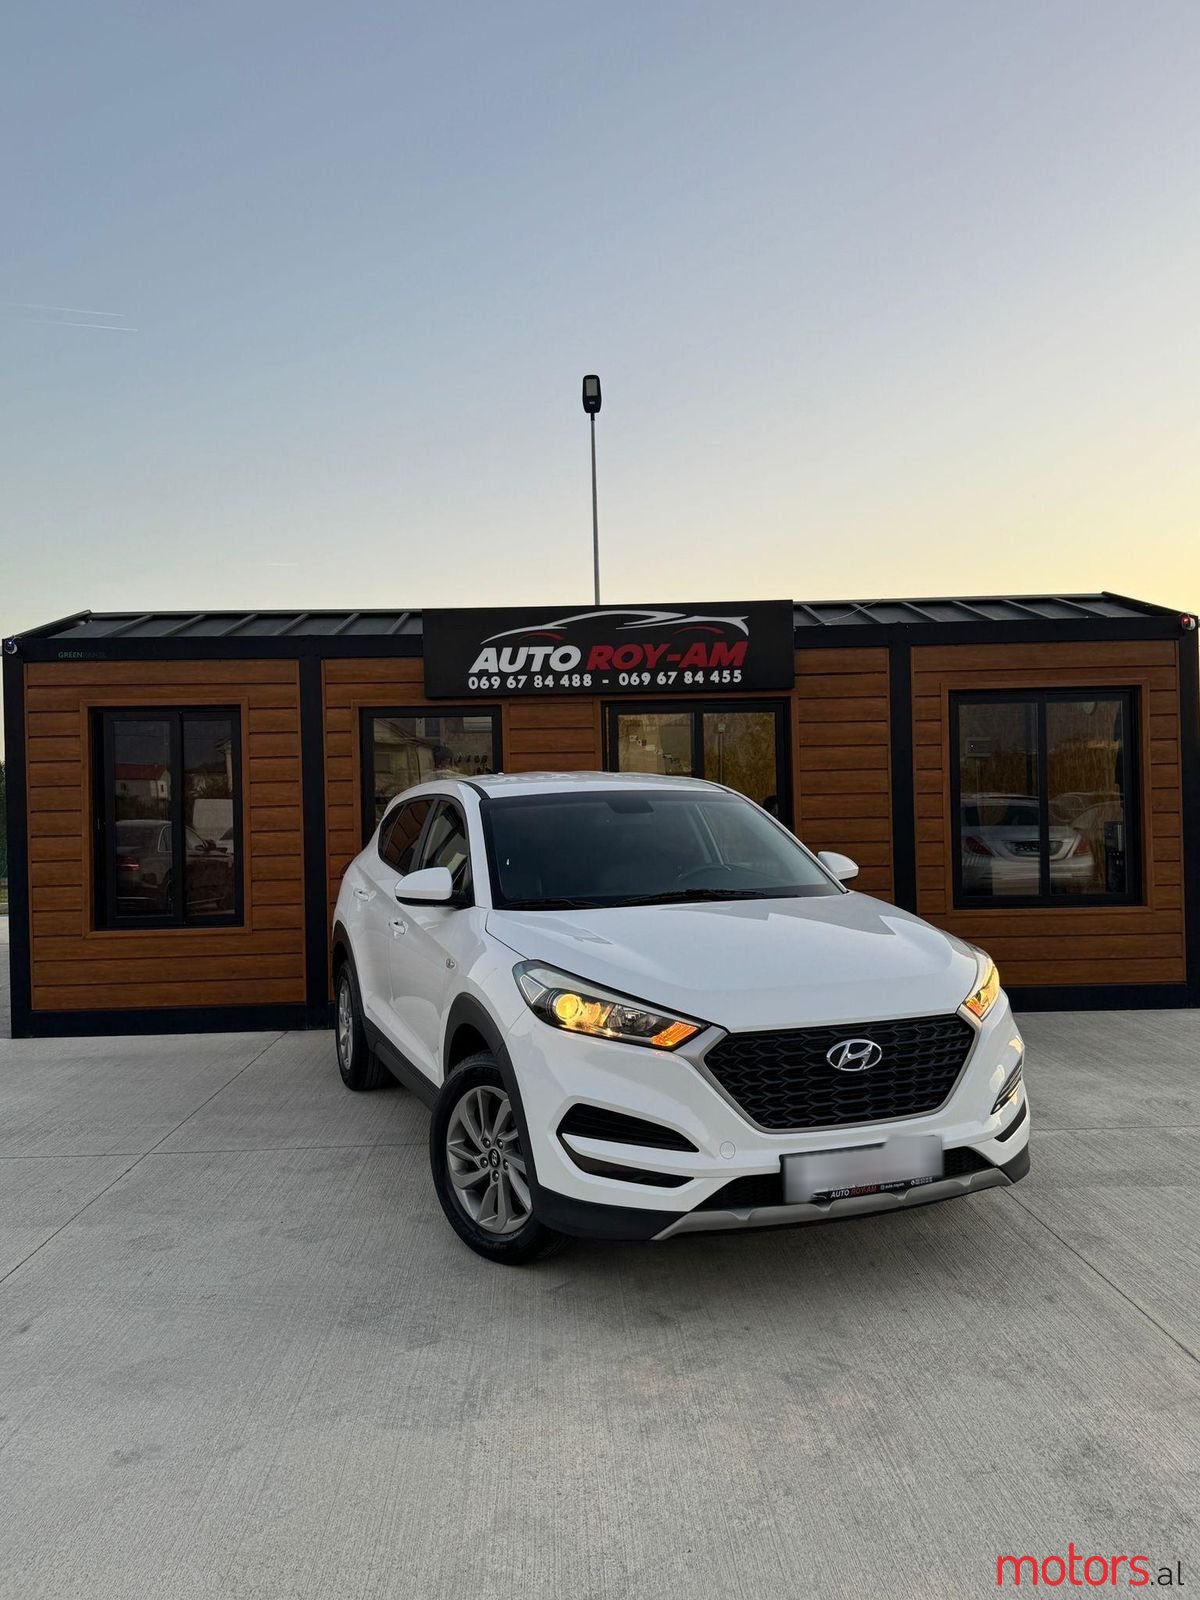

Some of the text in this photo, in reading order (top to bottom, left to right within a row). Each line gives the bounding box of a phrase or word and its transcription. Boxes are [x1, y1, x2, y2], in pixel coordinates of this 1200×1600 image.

[468, 641, 748, 673] AUTO ROY-AM
[468, 676, 501, 690] 069
[506, 675, 528, 689] 67
[533, 674, 554, 688] 84
[559, 673, 592, 687] 488
[618, 672, 651, 686] 069
[656, 671, 678, 685] 67
[683, 671, 704, 684] 84
[709, 669, 742, 683] 455
[830, 1189, 850, 1199] AUTO
